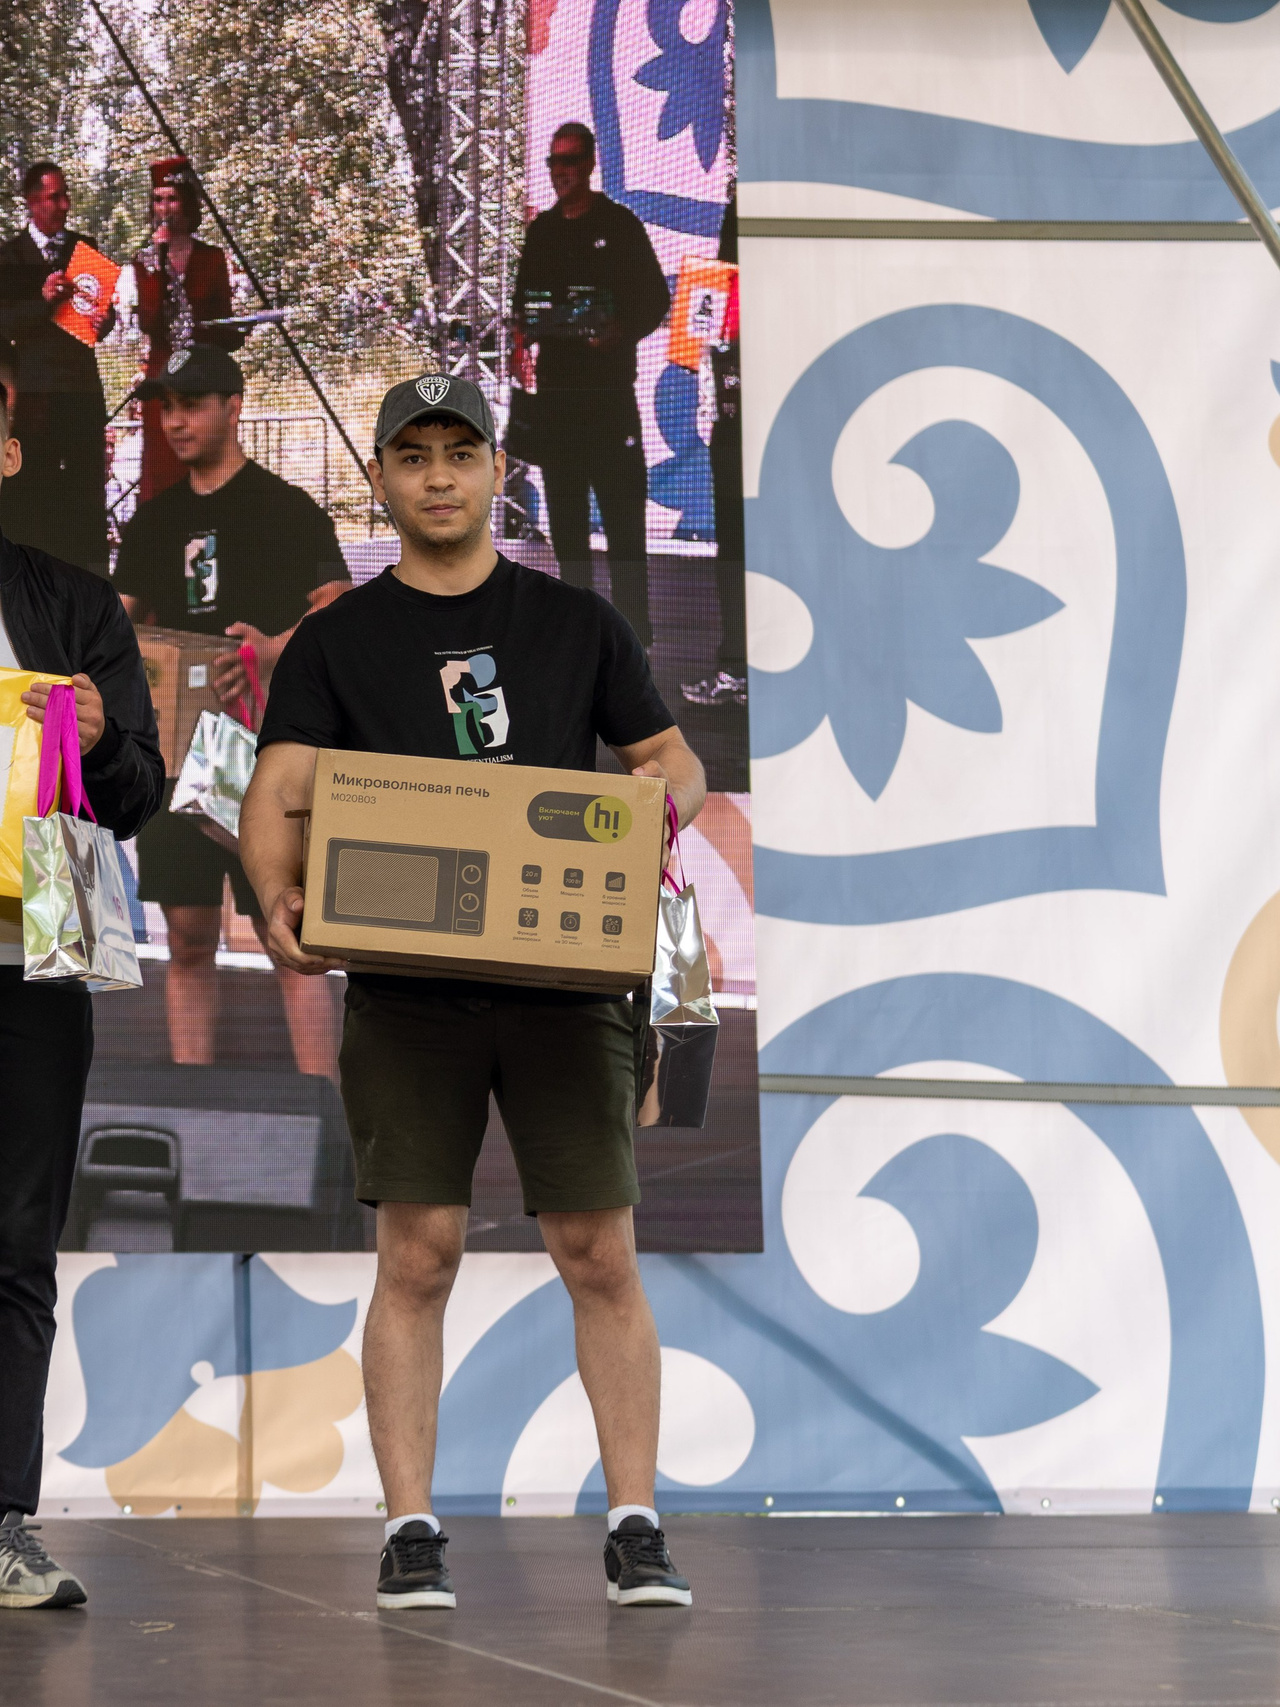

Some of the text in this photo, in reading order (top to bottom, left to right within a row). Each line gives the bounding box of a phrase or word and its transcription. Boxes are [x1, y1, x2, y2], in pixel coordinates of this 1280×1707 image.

[332, 772, 490, 798] Микроволновая печь
[538, 807, 580, 816] Включаем
